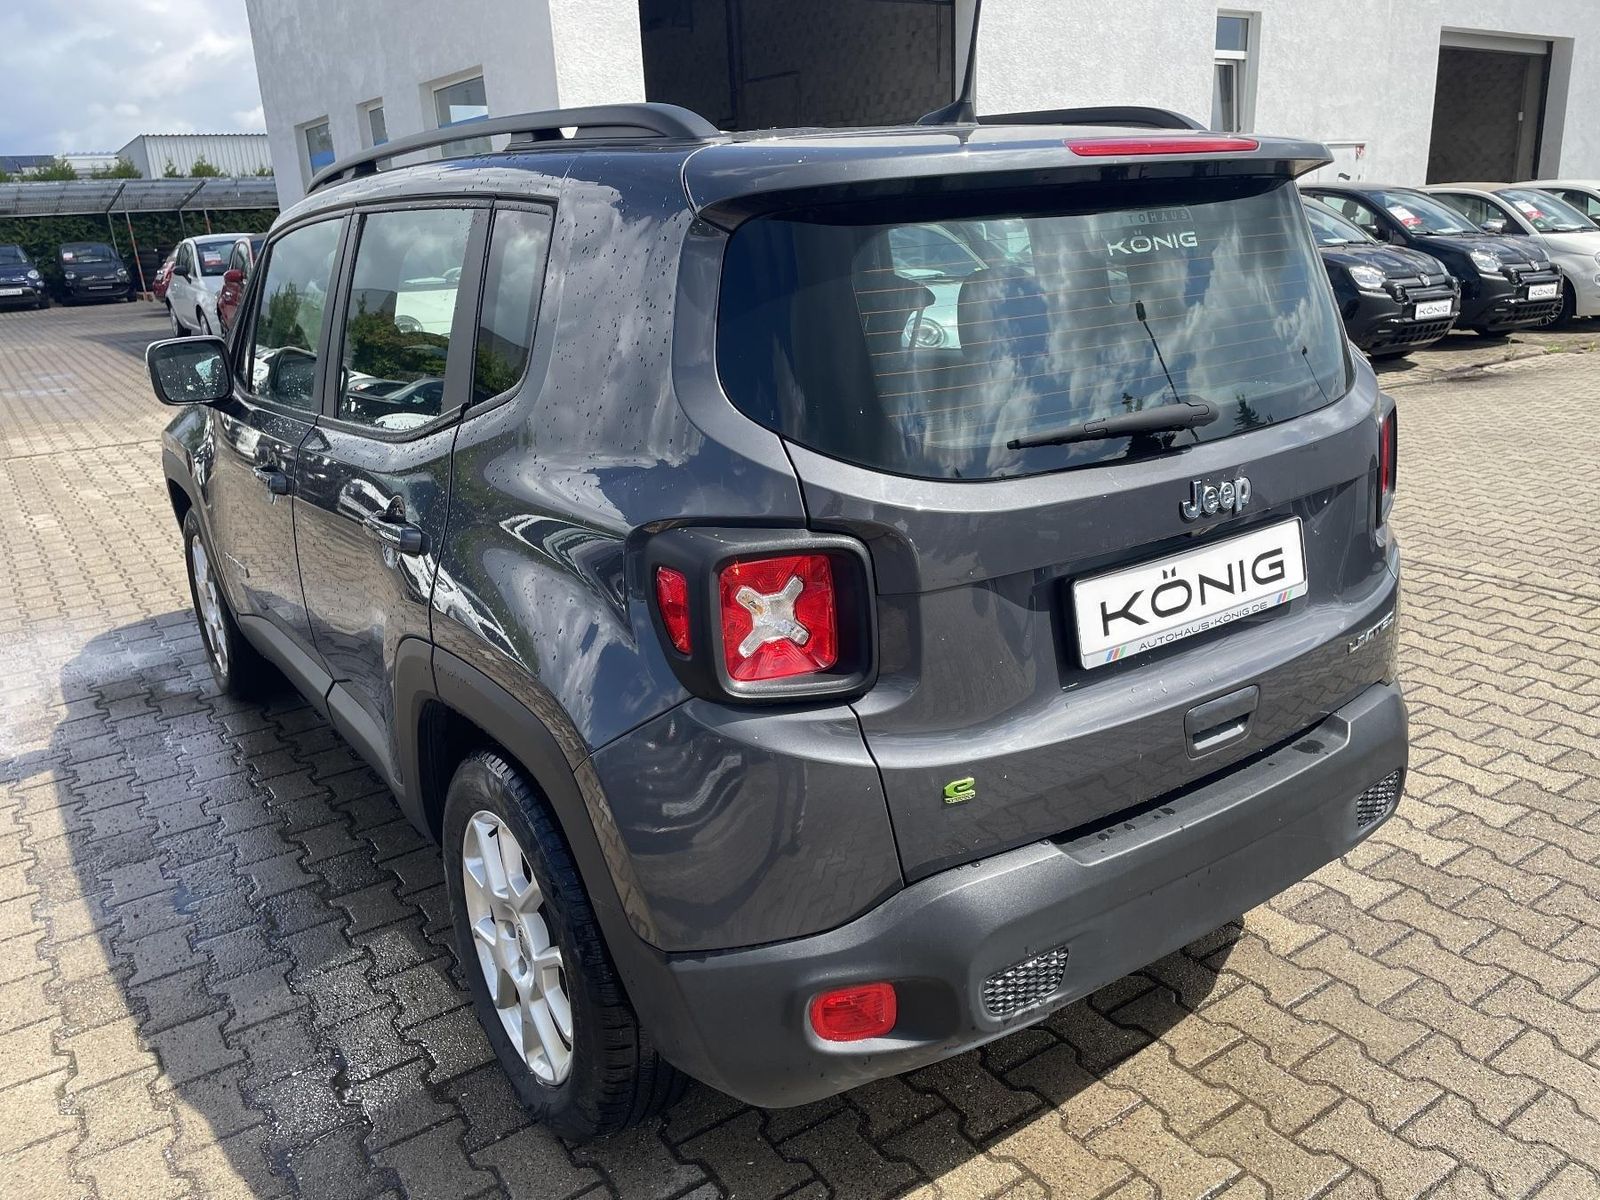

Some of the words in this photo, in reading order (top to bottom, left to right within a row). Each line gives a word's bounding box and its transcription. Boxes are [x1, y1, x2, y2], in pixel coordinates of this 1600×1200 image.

[1107, 229, 1198, 257] KÖNIG
[1180, 476, 1252, 519] Jeep
[1100, 547, 1286, 637] KÖNIG
